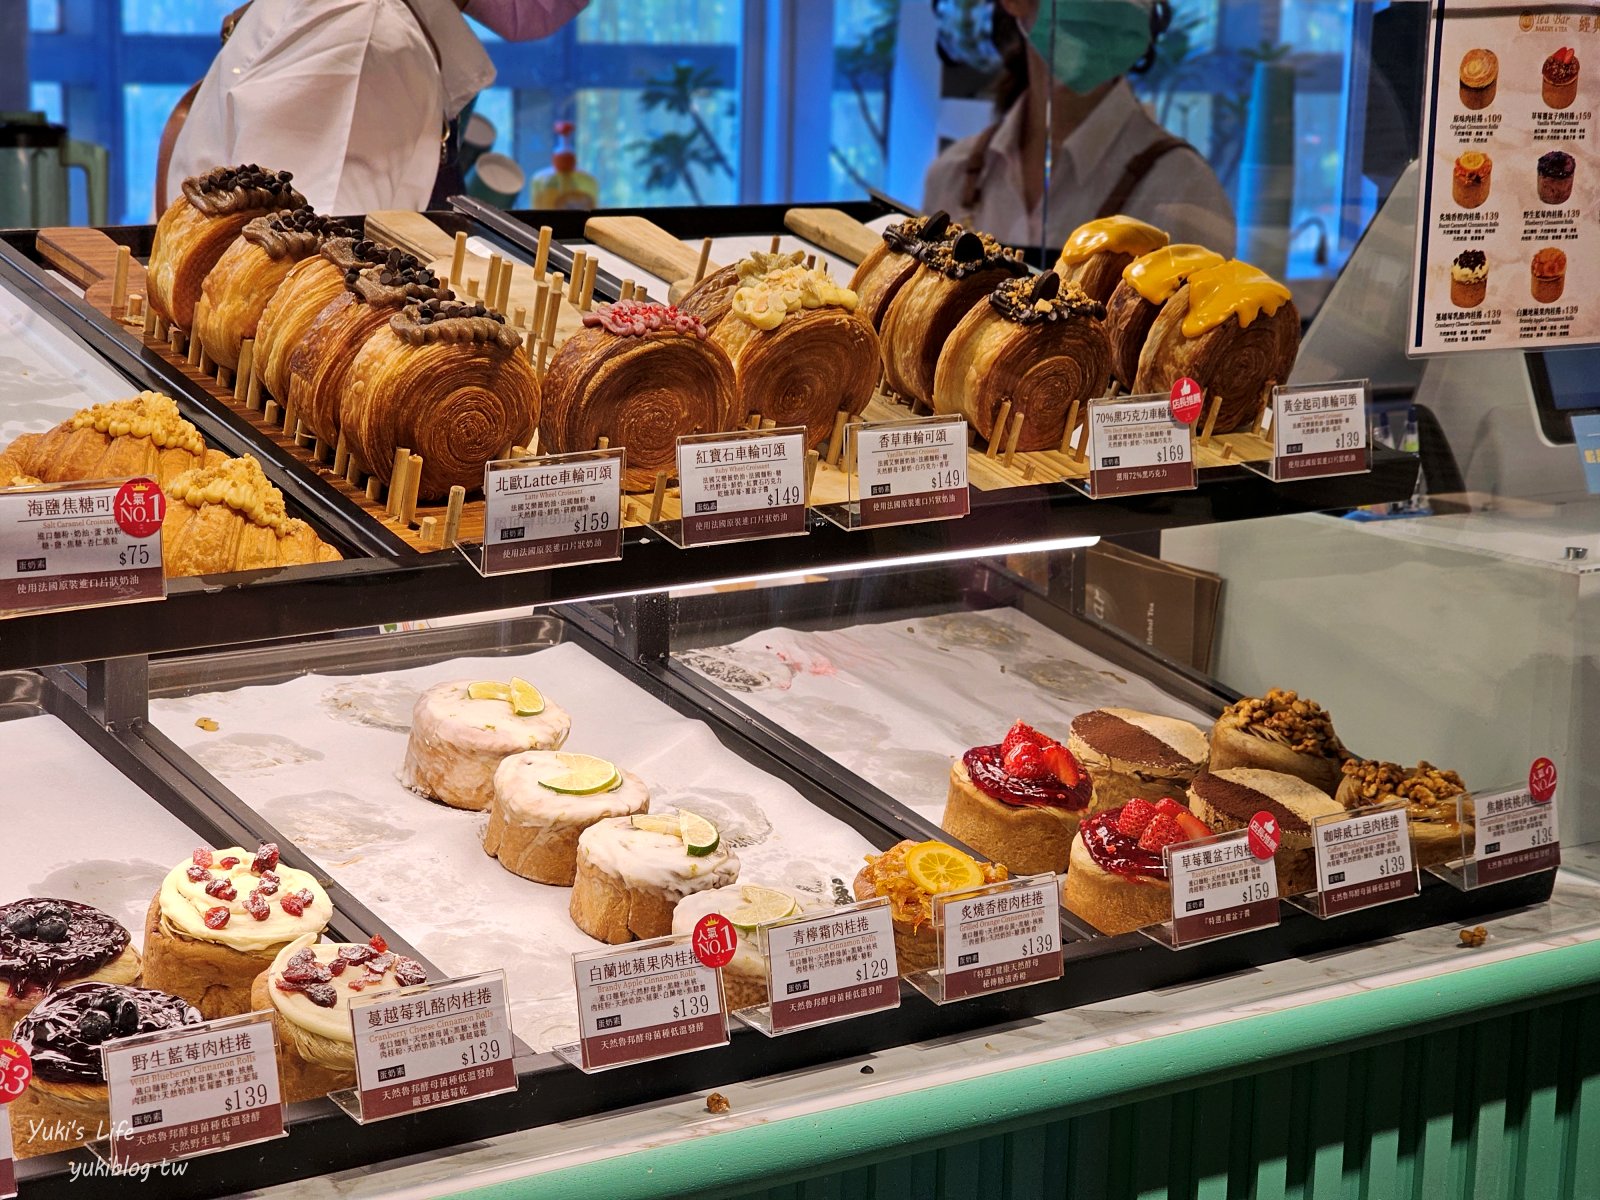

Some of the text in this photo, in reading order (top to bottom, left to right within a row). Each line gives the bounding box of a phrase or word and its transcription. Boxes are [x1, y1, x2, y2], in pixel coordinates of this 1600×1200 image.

[1096, 409, 1174, 423] 70%黑巧克力車輪可
[880, 429, 947, 448] 香草車輪可頌
[1336, 432, 1359, 448] $139
[696, 442, 785, 464] 紅寶石車輪可頌
[1158, 445, 1184, 462] $169
[746, 463, 769, 471] Croissant
[496, 465, 613, 492] 北歐Latte車輪可頌
[931, 470, 960, 488] $149
[27, 495, 115, 517] 海鹽焦糖可
[120, 493, 145, 506] 人氣
[525, 493, 539, 501] Latte
[558, 489, 583, 497] Croissant
[768, 486, 799, 506] $149
[43, 521, 56, 529] Salt
[57, 519, 85, 528] Caramel
[574, 512, 609, 533] $159
[695, 513, 788, 531] 使用法國原裝進口片狀奶油
[119, 544, 149, 566] $75
[503, 540, 602, 559] 使用法國原裝進口片狀奶油
[17, 575, 139, 594] 使用法國原裝進口片狀奶油
[1380, 856, 1405, 875] $139
[1243, 882, 1269, 902] $159
[962, 891, 1043, 920] 炙燒香橙肉桂捲
[698, 927, 718, 942] 人氣
[794, 916, 869, 945] 青檸霜肉桂捲
[788, 951, 804, 959] Lime
[805, 945, 828, 956] Frosted
[830, 938, 861, 950] Cinnamon
[1022, 934, 1052, 956] $139
[856, 958, 888, 982] $129
[597, 970, 696, 993] Brandy Apple Cinnamon Rolls
[367, 987, 492, 1029] 蔓越莓乳酪肉桂捲
[673, 995, 709, 1019] $139
[790, 984, 883, 1012] 天然魯邦酵母菌種低溫發酵
[369, 1010, 493, 1043] Cranberry Cheese Cinnamon Rolls
[601, 1022, 704, 1050] 天然魯邦酵母菌種低溫發酵
[131, 1032, 252, 1072] 野生藍莓肉桂捲
[461, 1040, 500, 1066] $139
[131, 1054, 256, 1086] Wild Blueberry Cinnamon Rolls
[382, 1067, 495, 1101] 天然魯邦酵母菌種低溫發酵
[225, 1084, 267, 1112] $139
[136, 1112, 260, 1146] 天然魯邦酵母菌種低溫發酵
[170, 1132, 231, 1153] 天然野生藍莓
